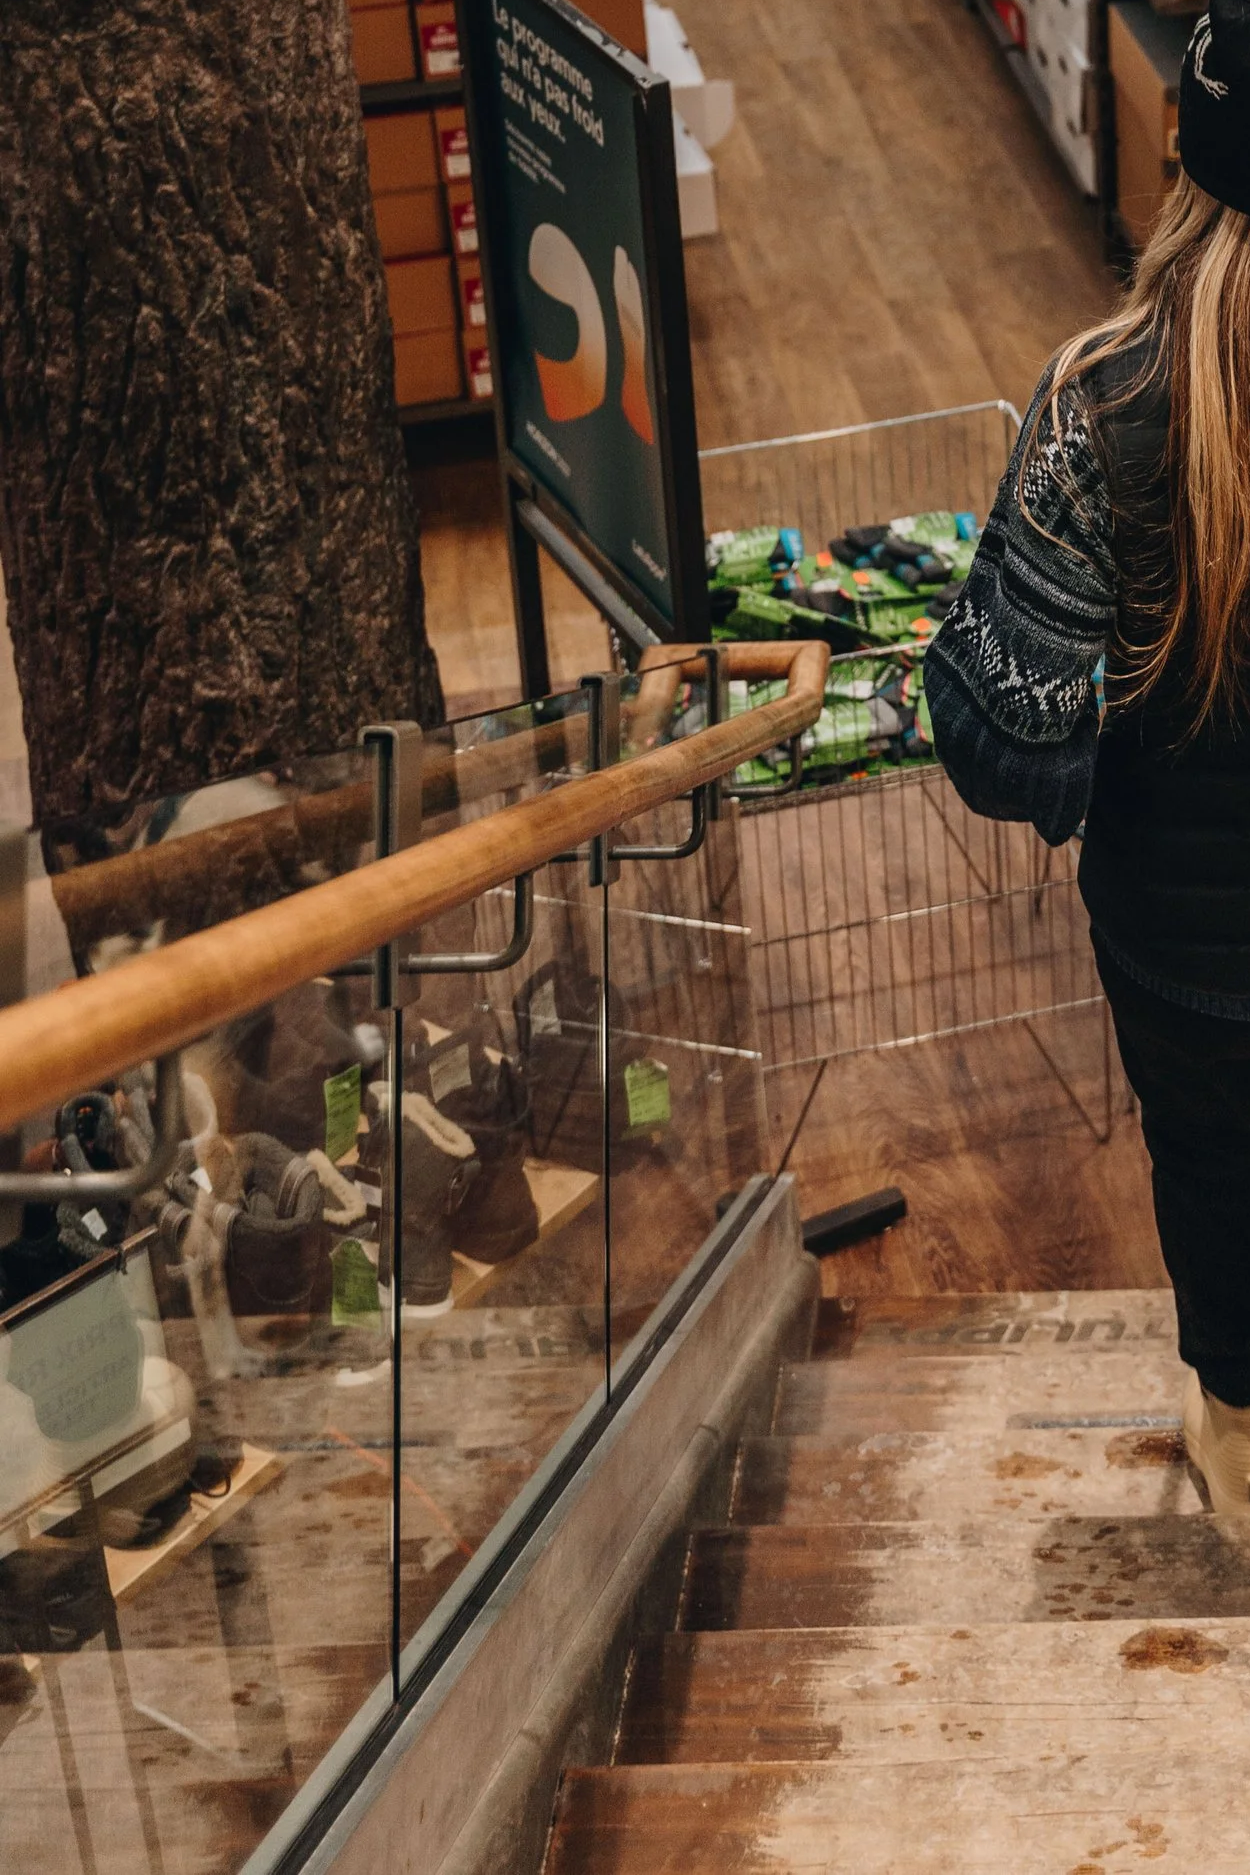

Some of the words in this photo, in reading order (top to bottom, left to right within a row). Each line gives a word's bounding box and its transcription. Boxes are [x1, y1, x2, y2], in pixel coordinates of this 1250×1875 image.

[511, 15, 594, 102] programme
[500, 70, 527, 109] aux
[527, 93, 567, 145] yeux.
[543, 75, 571, 115] pas
[571, 92, 605, 149] froid
